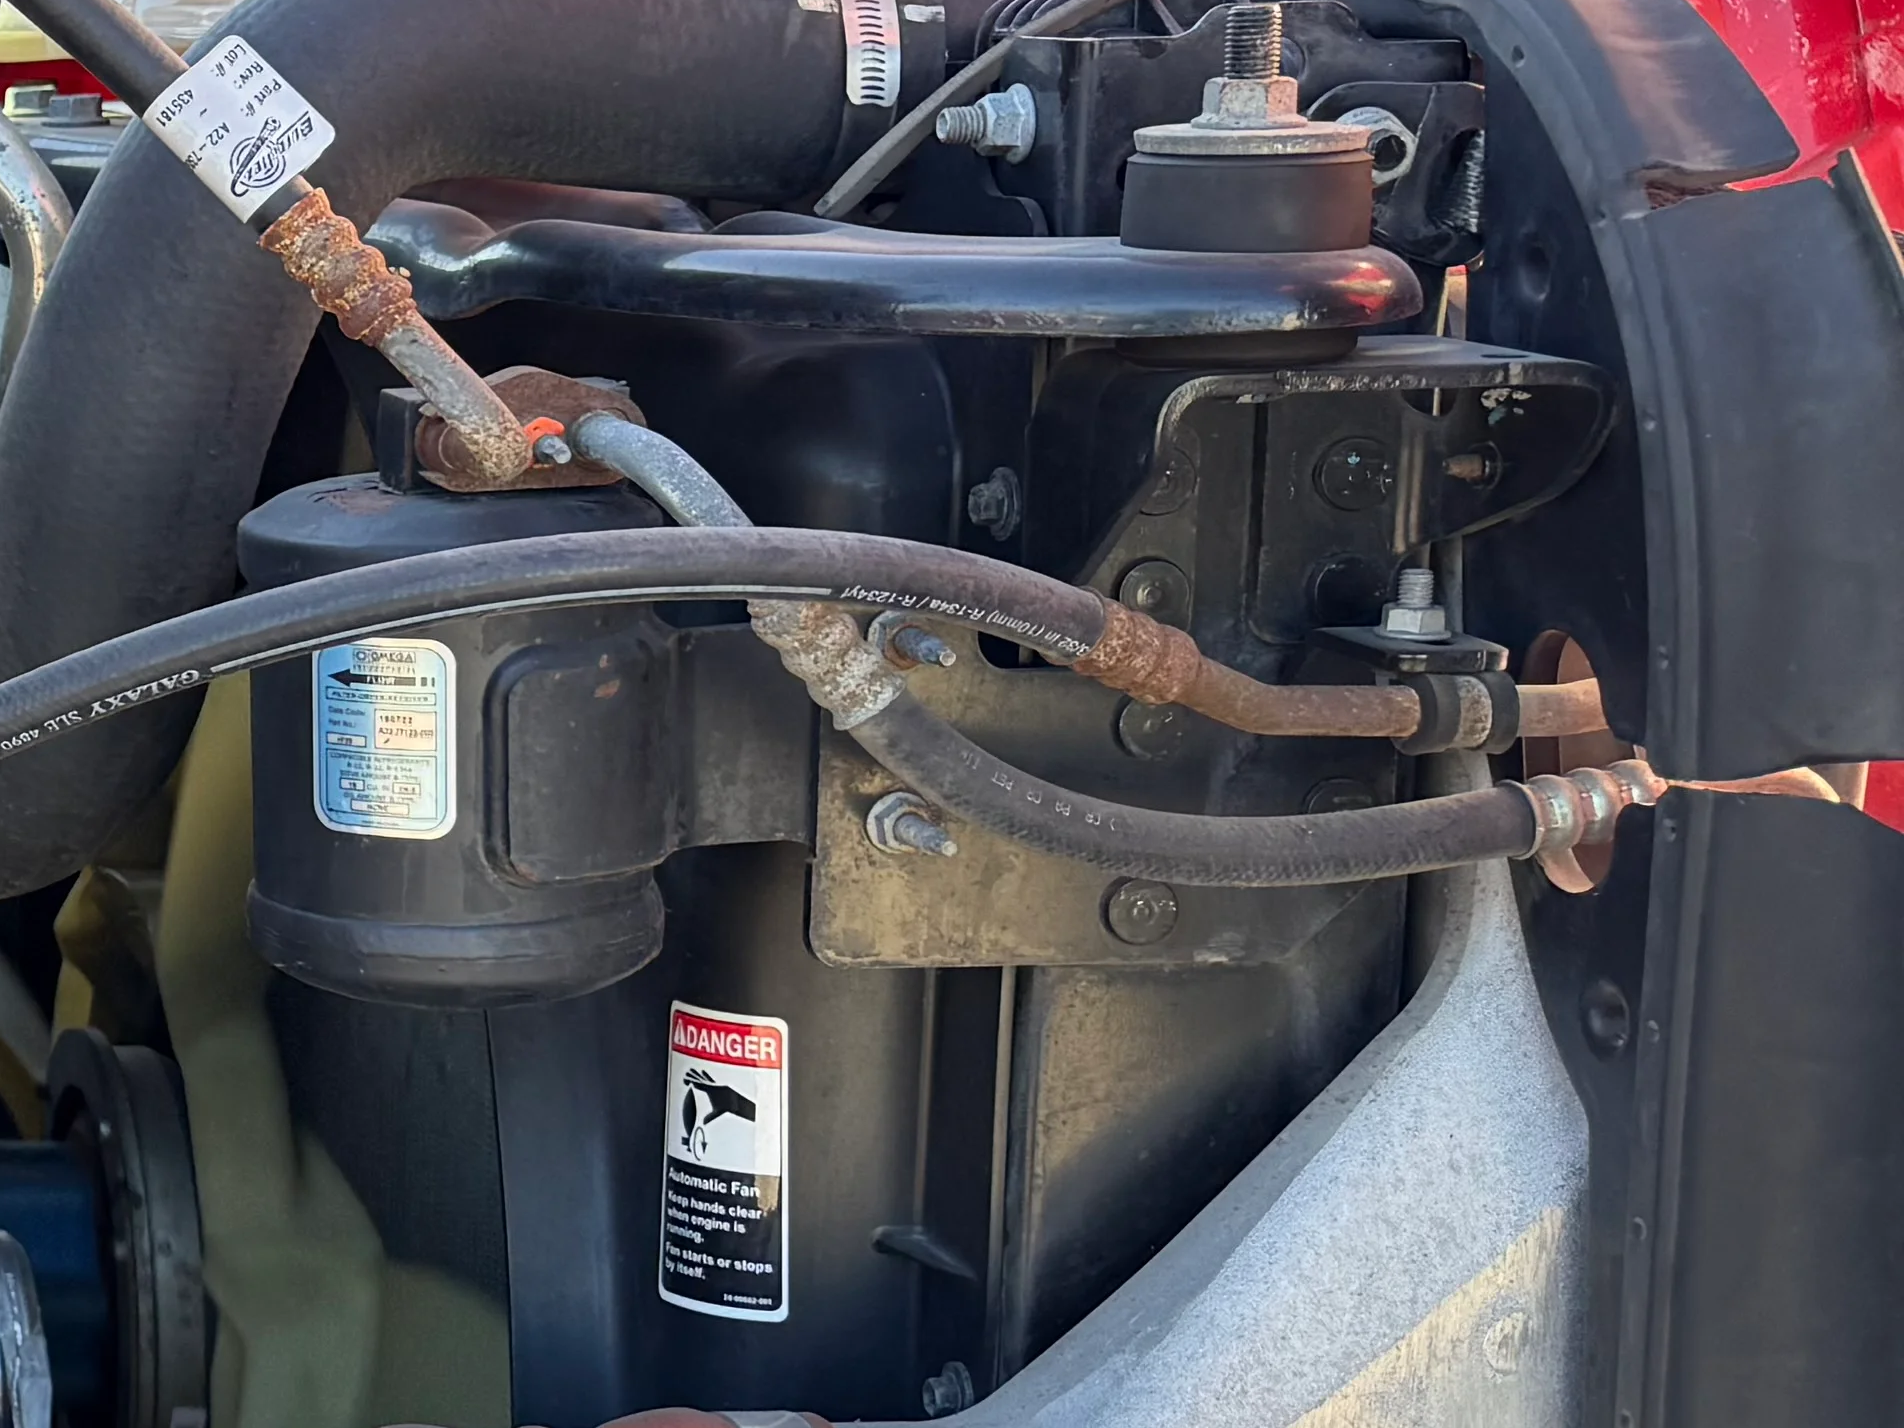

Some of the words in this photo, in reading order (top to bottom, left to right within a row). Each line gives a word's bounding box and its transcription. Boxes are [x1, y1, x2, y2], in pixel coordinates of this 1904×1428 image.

[90, 668, 201, 717] GALAXY
[686, 1025, 777, 1062] DANGER
[668, 1167, 727, 1194] Automatic
[731, 1181, 760, 1198] Fan
[667, 1207, 689, 1222] when
[691, 1215, 730, 1232] engine
[733, 1221, 746, 1233] is
[668, 1190, 689, 1207] Keep
[690, 1197, 726, 1215] hands
[728, 1206, 762, 1220] clear
[666, 1222, 704, 1244] running.
[665, 1241, 681, 1257] Fan
[682, 1249, 714, 1265] starts
[717, 1259, 731, 1268] or
[733, 1260, 773, 1275] stops
[665, 1257, 675, 1272] by
[676, 1262, 706, 1280] itself.
